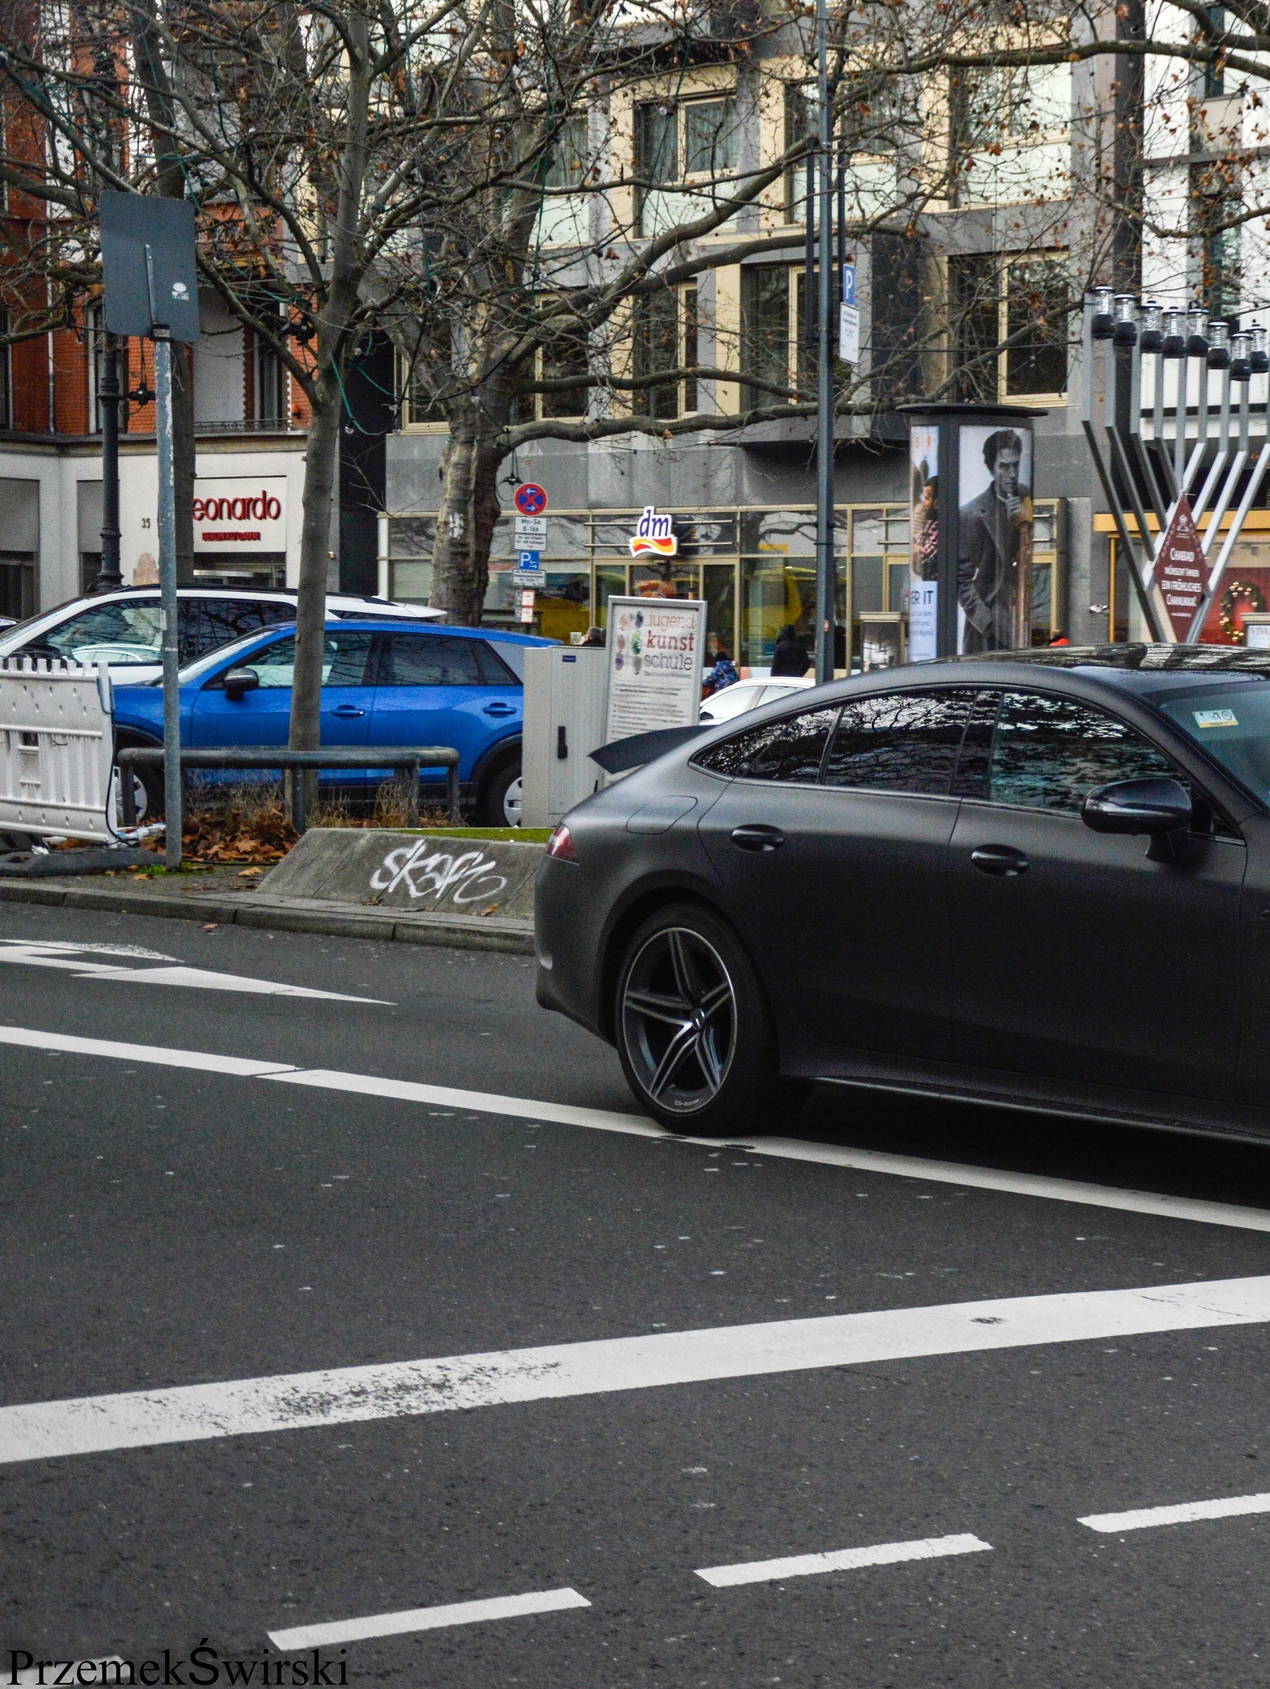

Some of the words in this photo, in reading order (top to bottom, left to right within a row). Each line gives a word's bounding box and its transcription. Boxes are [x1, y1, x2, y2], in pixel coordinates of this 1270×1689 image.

[845, 269, 854, 300] P
[192, 490, 282, 521] eonardo
[141, 518, 151, 529] 35
[639, 509, 669, 537] dm
[520, 552, 532, 567] P
[648, 612, 695, 631] jugend
[646, 630, 695, 652] kunst
[644, 653, 693, 671] schule
